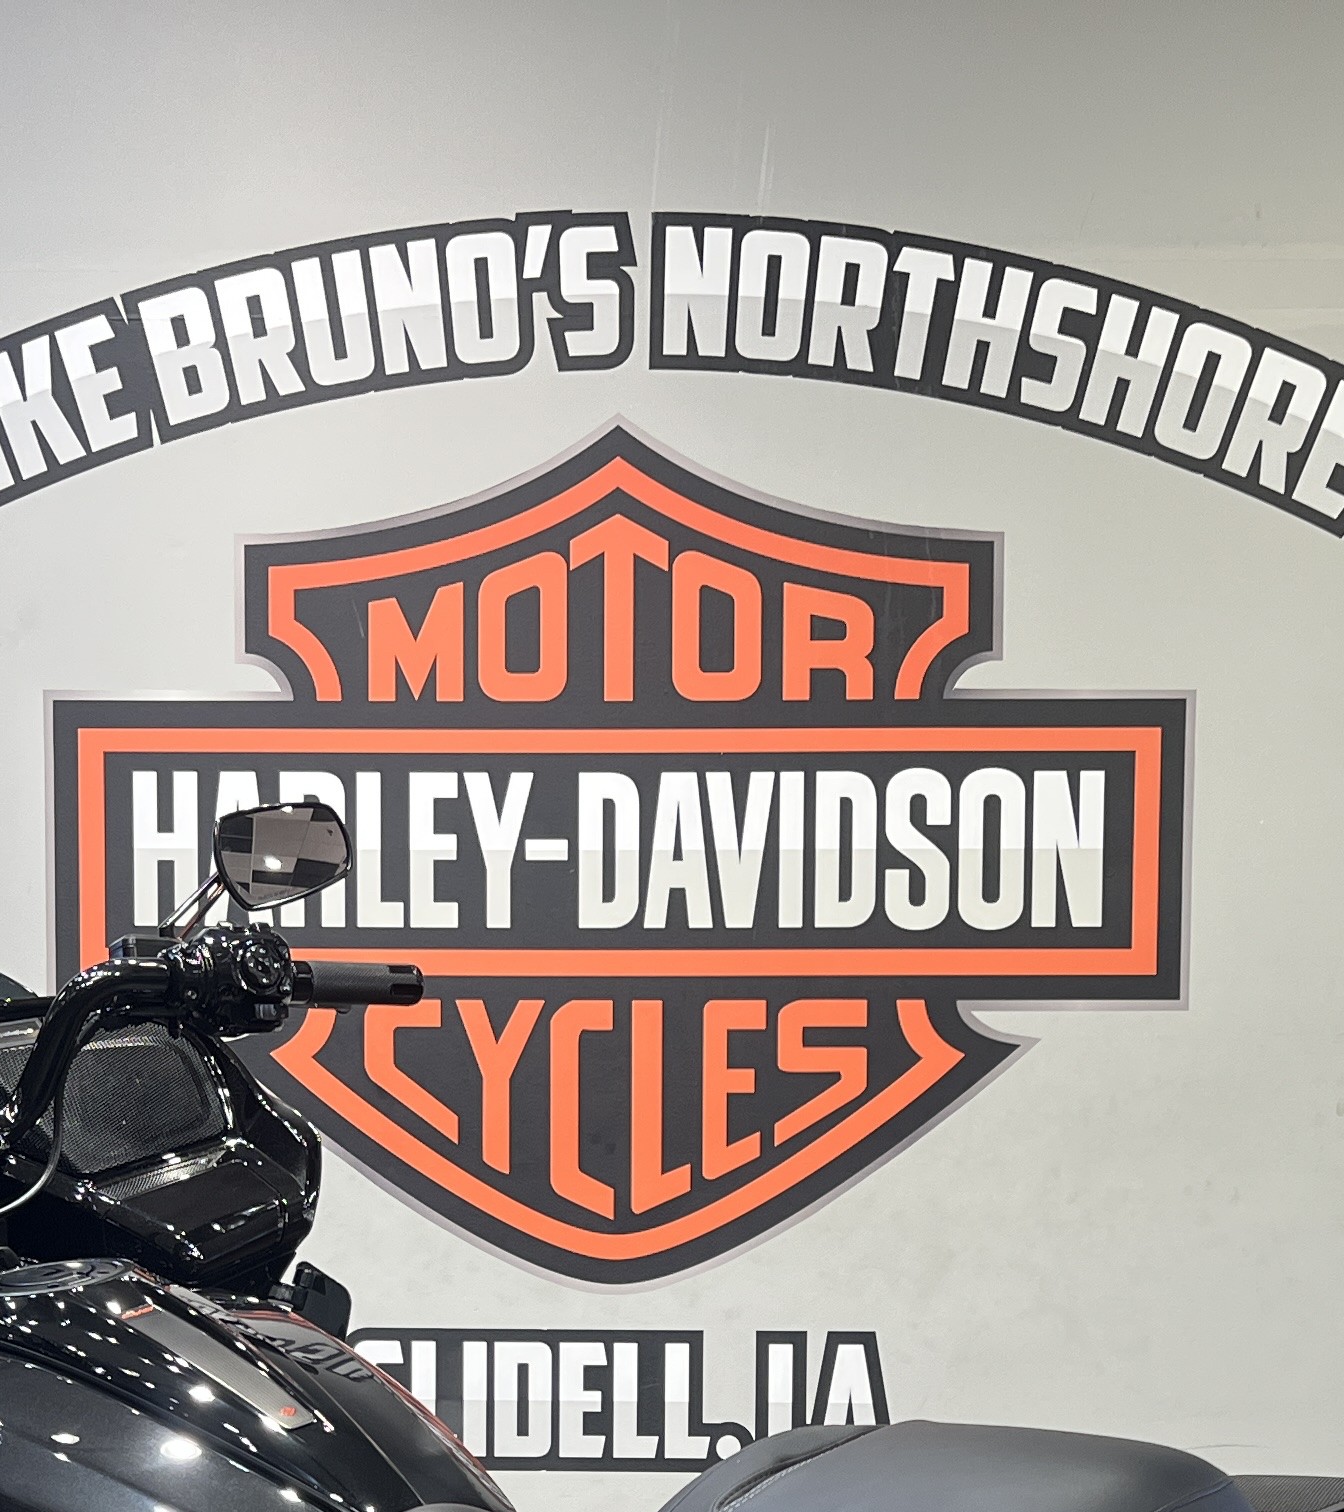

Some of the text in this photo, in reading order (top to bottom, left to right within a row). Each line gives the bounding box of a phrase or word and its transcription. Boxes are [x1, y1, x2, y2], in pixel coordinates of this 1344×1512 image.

[137, 224, 622, 427] BRUNO'S
[369, 515, 874, 702] MOTOR
[364, 1000, 868, 1220] CYCLES
